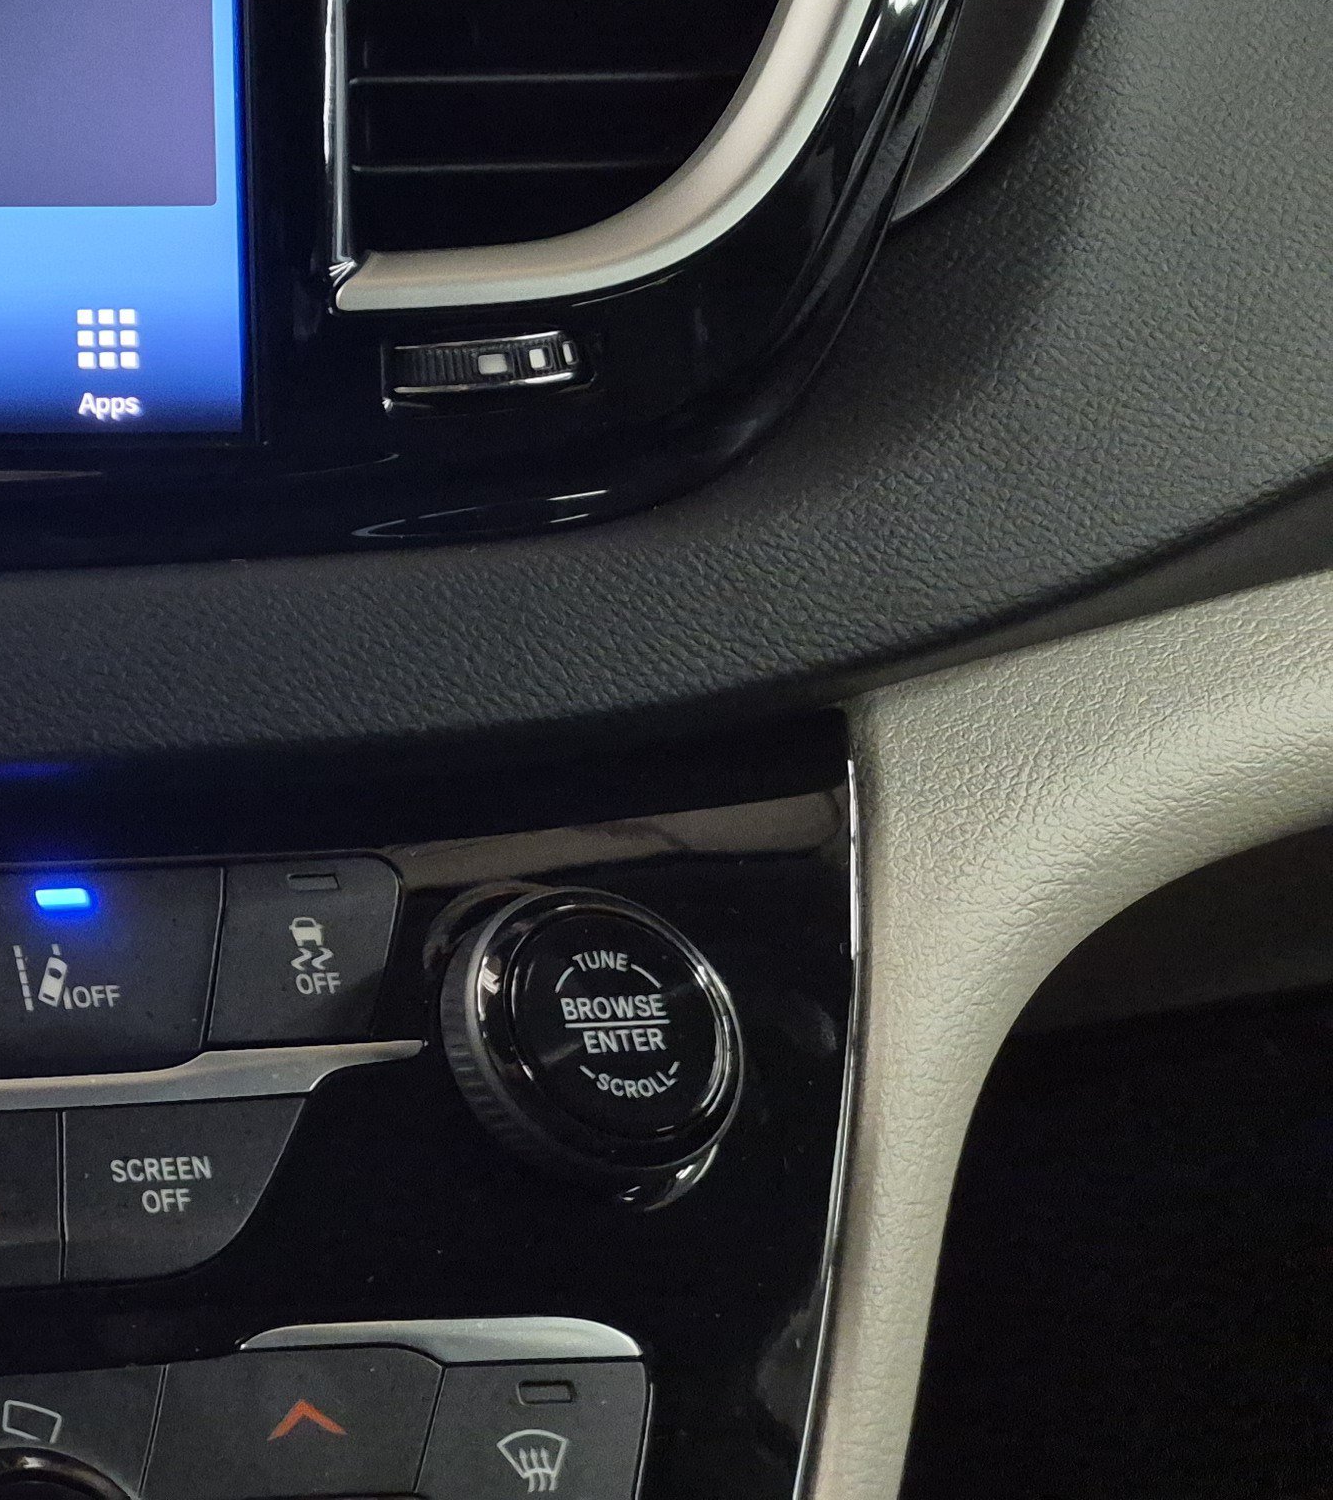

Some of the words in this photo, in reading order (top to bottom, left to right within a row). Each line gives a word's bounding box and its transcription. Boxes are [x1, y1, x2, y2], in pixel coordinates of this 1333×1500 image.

[78, 392, 140, 421] Apps
[572, 949, 629, 973] TUNE
[72, 984, 120, 1009] OFF
[295, 972, 341, 995] OFF
[560, 993, 668, 1021] BROWSE
[583, 1027, 668, 1054] ENTER
[595, 1071, 678, 1099] SCROLL
[110, 1155, 212, 1186] SCREEN
[141, 1188, 191, 1214] OFF
